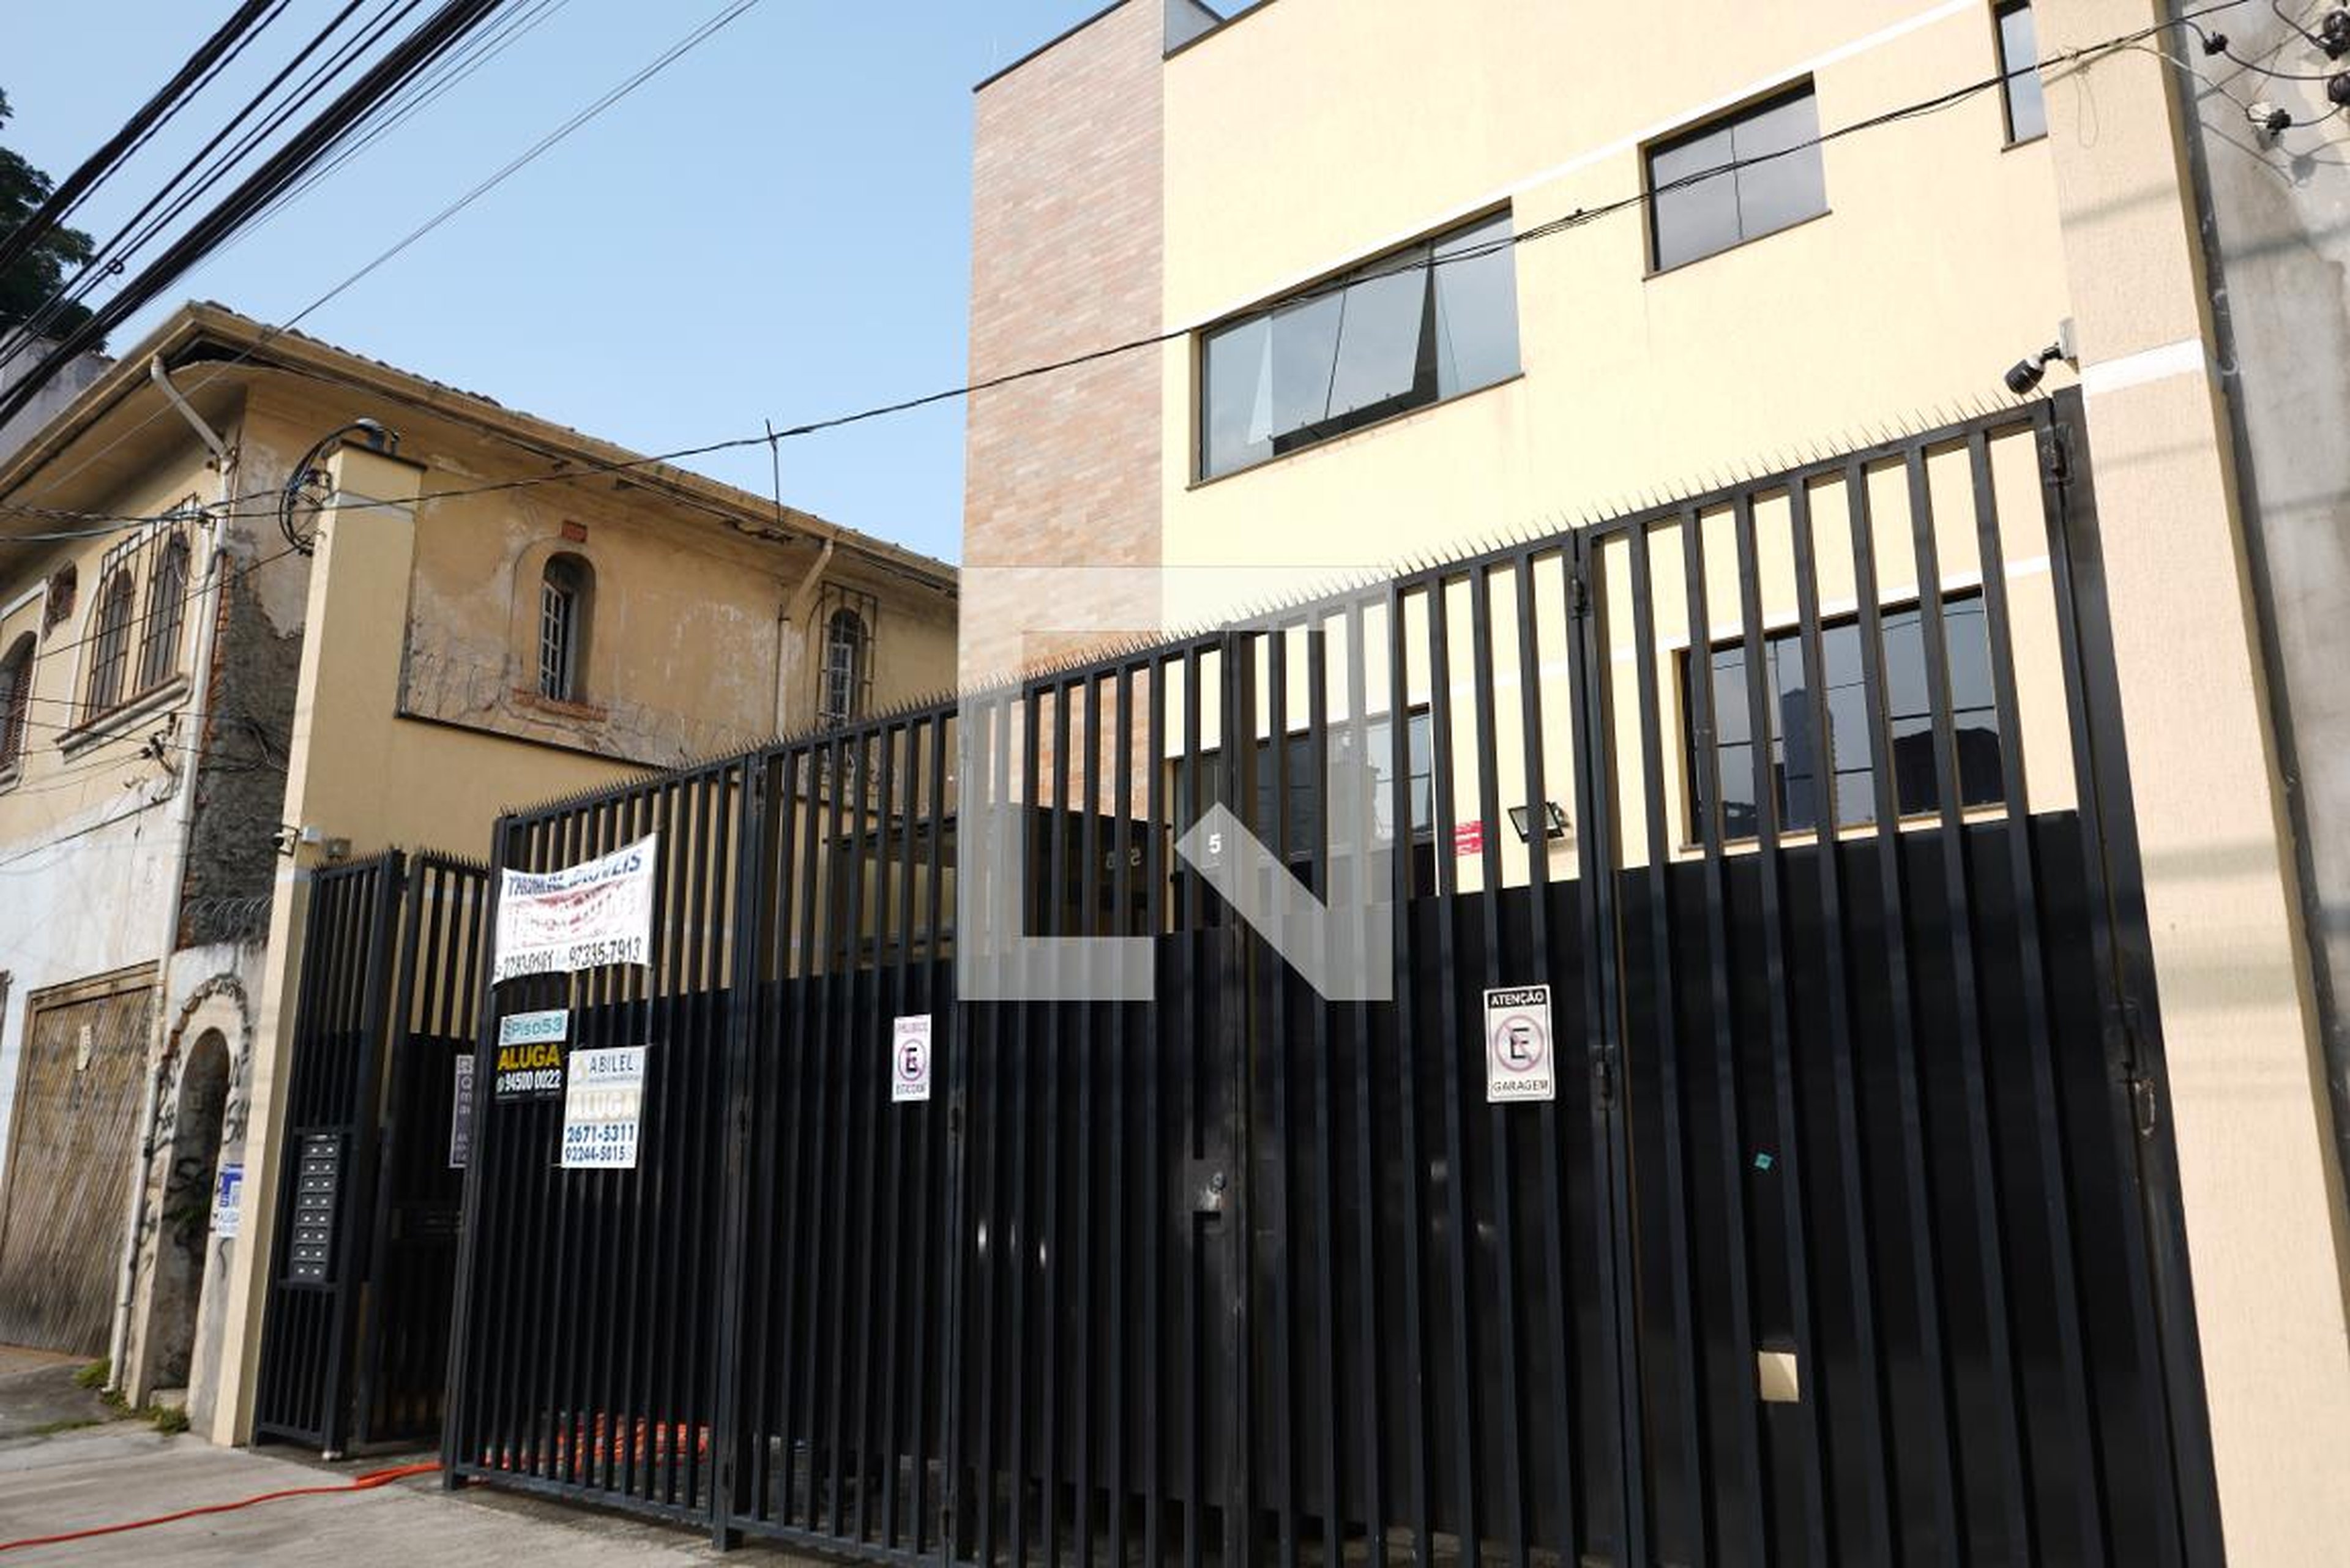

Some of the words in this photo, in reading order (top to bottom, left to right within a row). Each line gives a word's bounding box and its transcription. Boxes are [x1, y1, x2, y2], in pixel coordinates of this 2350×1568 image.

[1491, 990, 1544, 1006] ATENÇÃO
[1510, 1028, 1529, 1059] E
[498, 1044, 560, 1070] ALUGA
[1494, 1080, 1548, 1092] GARAGEM
[566, 1123, 634, 1143] 2671-5311
